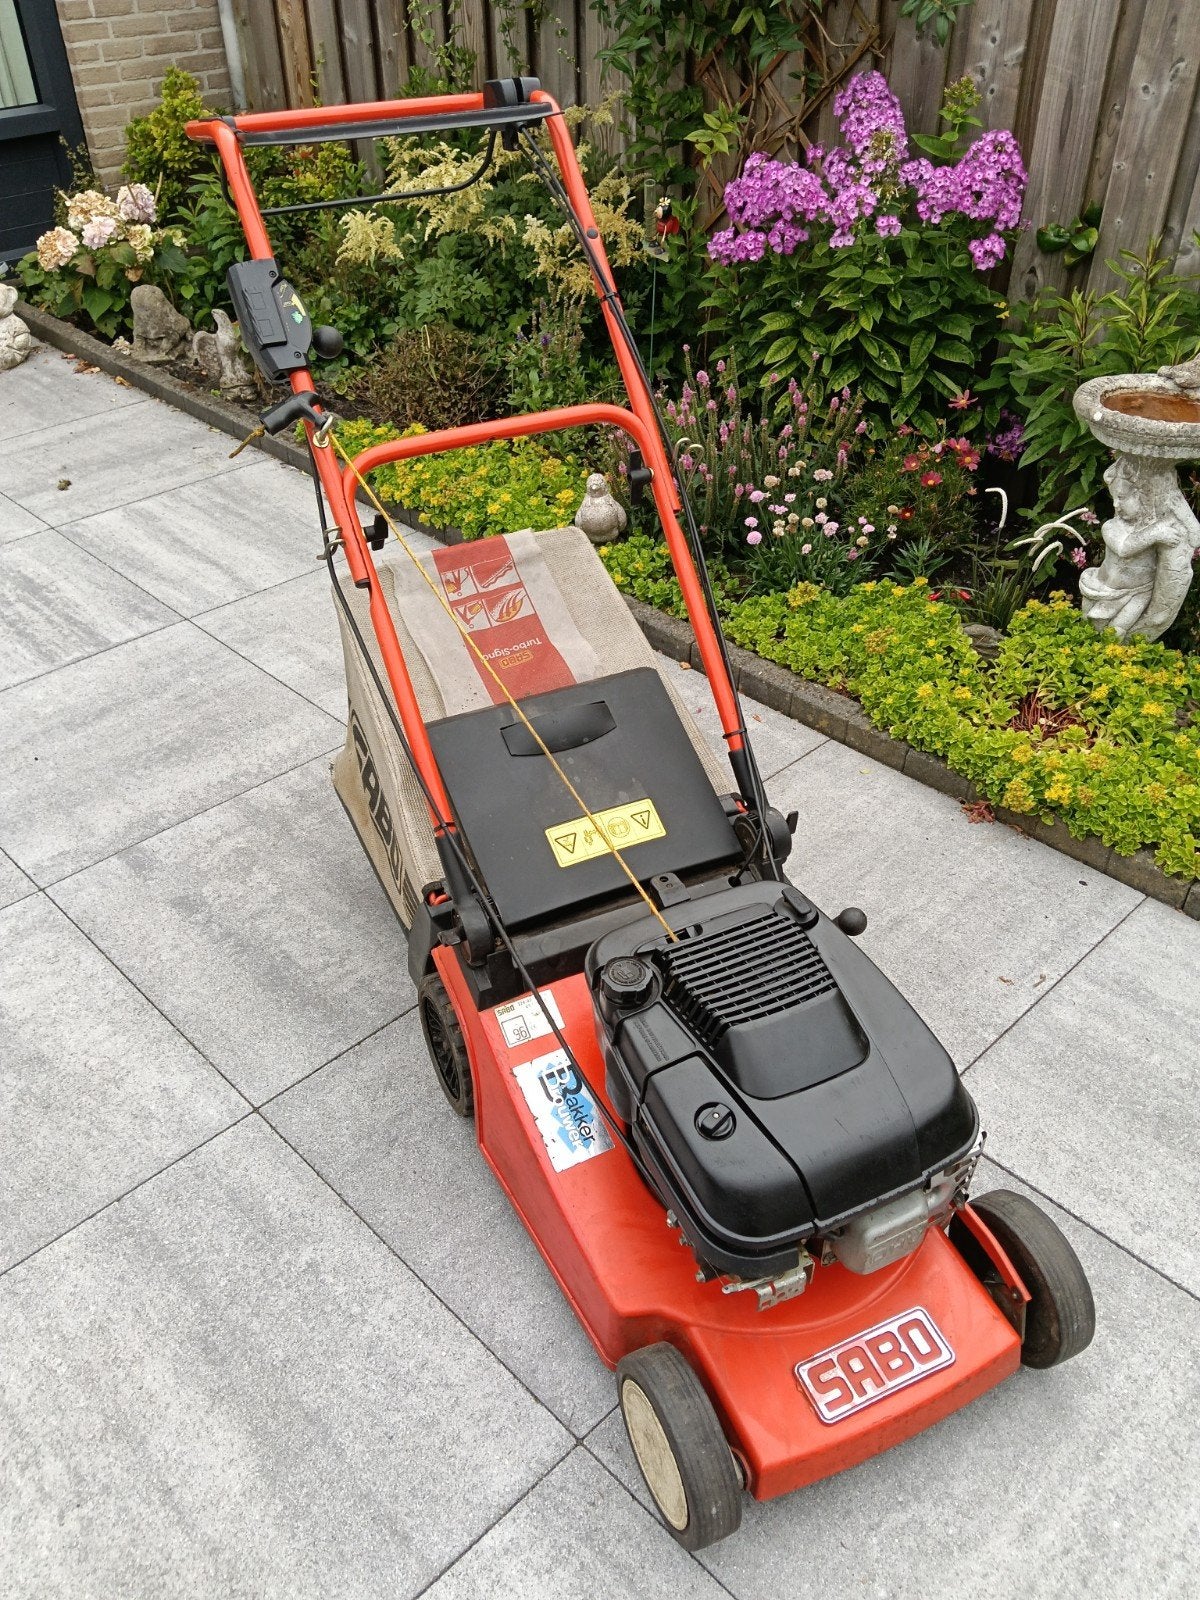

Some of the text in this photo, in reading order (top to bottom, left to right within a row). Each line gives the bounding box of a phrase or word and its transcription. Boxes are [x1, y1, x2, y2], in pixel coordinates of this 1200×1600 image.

[500, 650, 532, 668] SABO
[496, 1004, 515, 1017] SABO
[513, 1026, 528, 1041] 96
[807, 1317, 942, 1412] SABO
